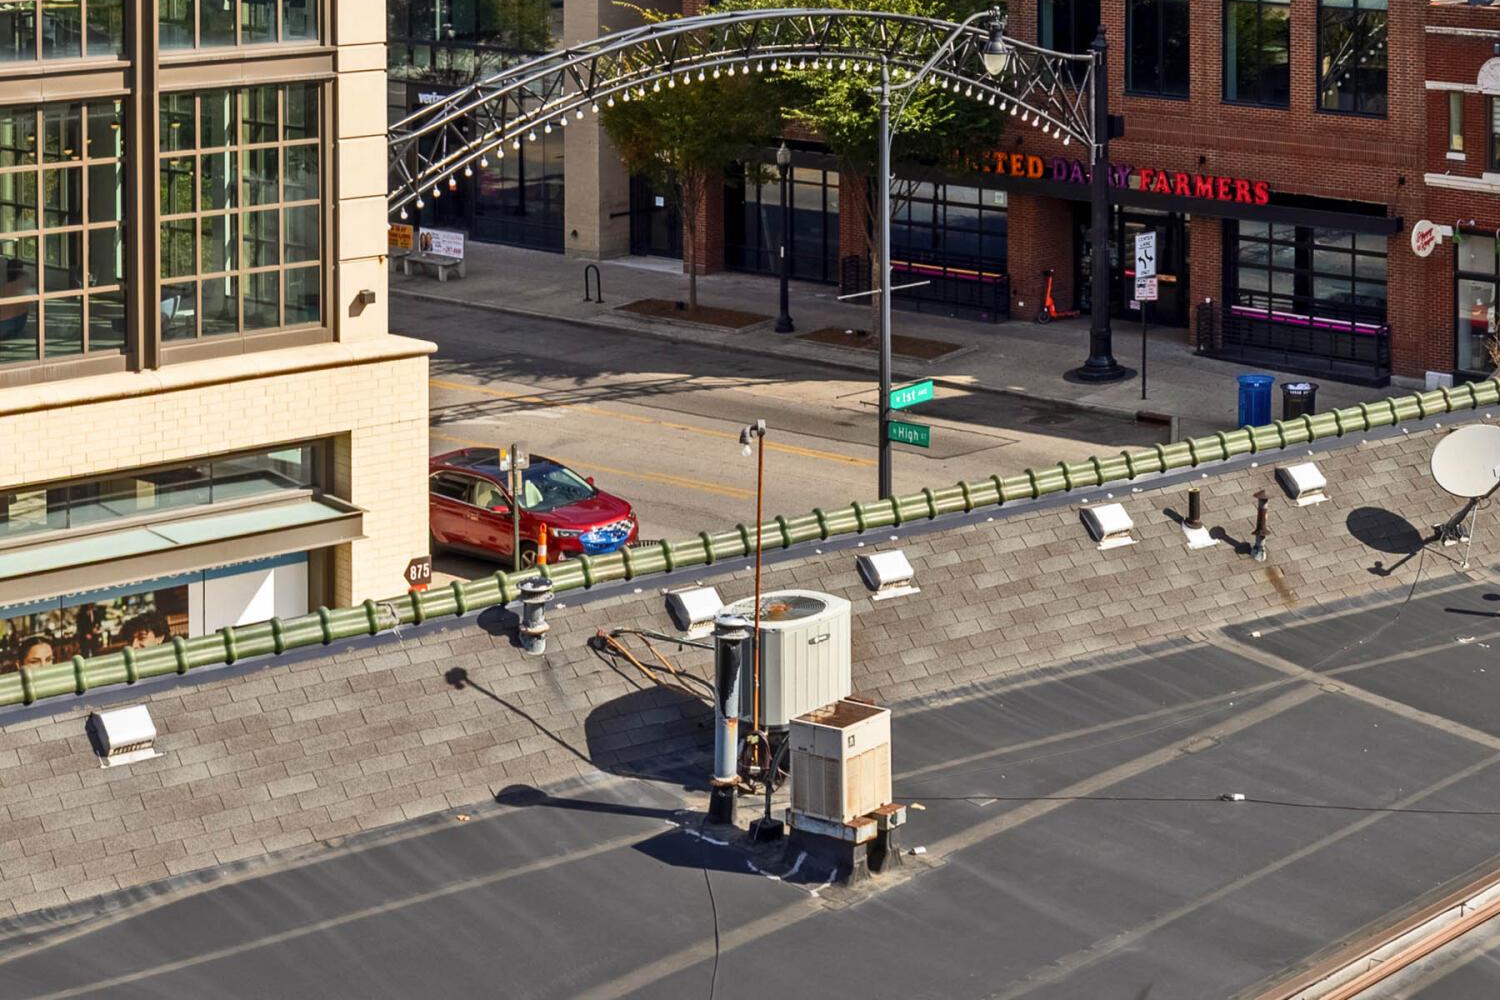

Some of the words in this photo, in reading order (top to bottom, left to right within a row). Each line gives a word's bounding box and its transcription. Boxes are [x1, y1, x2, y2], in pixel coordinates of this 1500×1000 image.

[1053, 157, 1133, 190] DAY
[1139, 167, 1270, 206] FARMERS
[898, 425, 919, 443] High
[410, 562, 430, 580] 875
